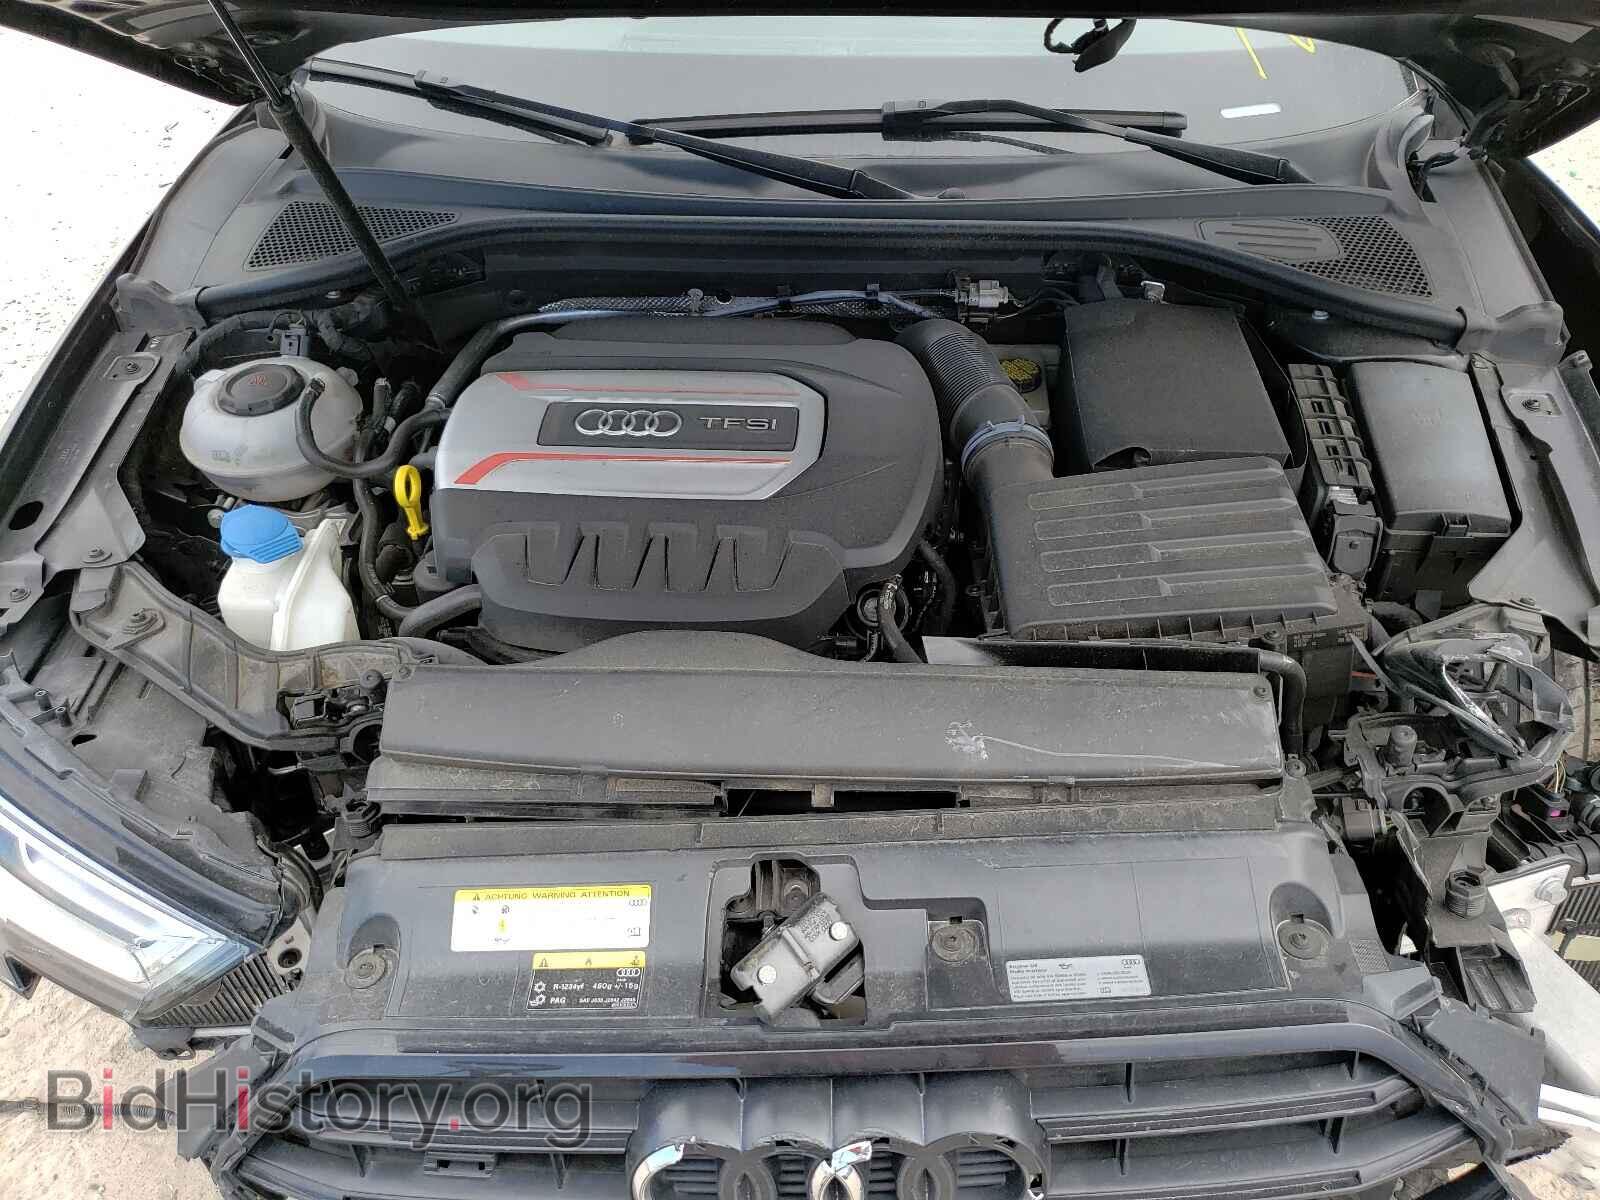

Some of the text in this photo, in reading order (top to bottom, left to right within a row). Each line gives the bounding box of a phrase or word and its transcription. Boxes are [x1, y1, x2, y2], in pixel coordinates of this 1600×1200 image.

[699, 416, 778, 432] TFSI
[484, 889, 631, 901] ACHTUNG WARNING ATTENTION
[549, 996, 567, 1004] PAG
